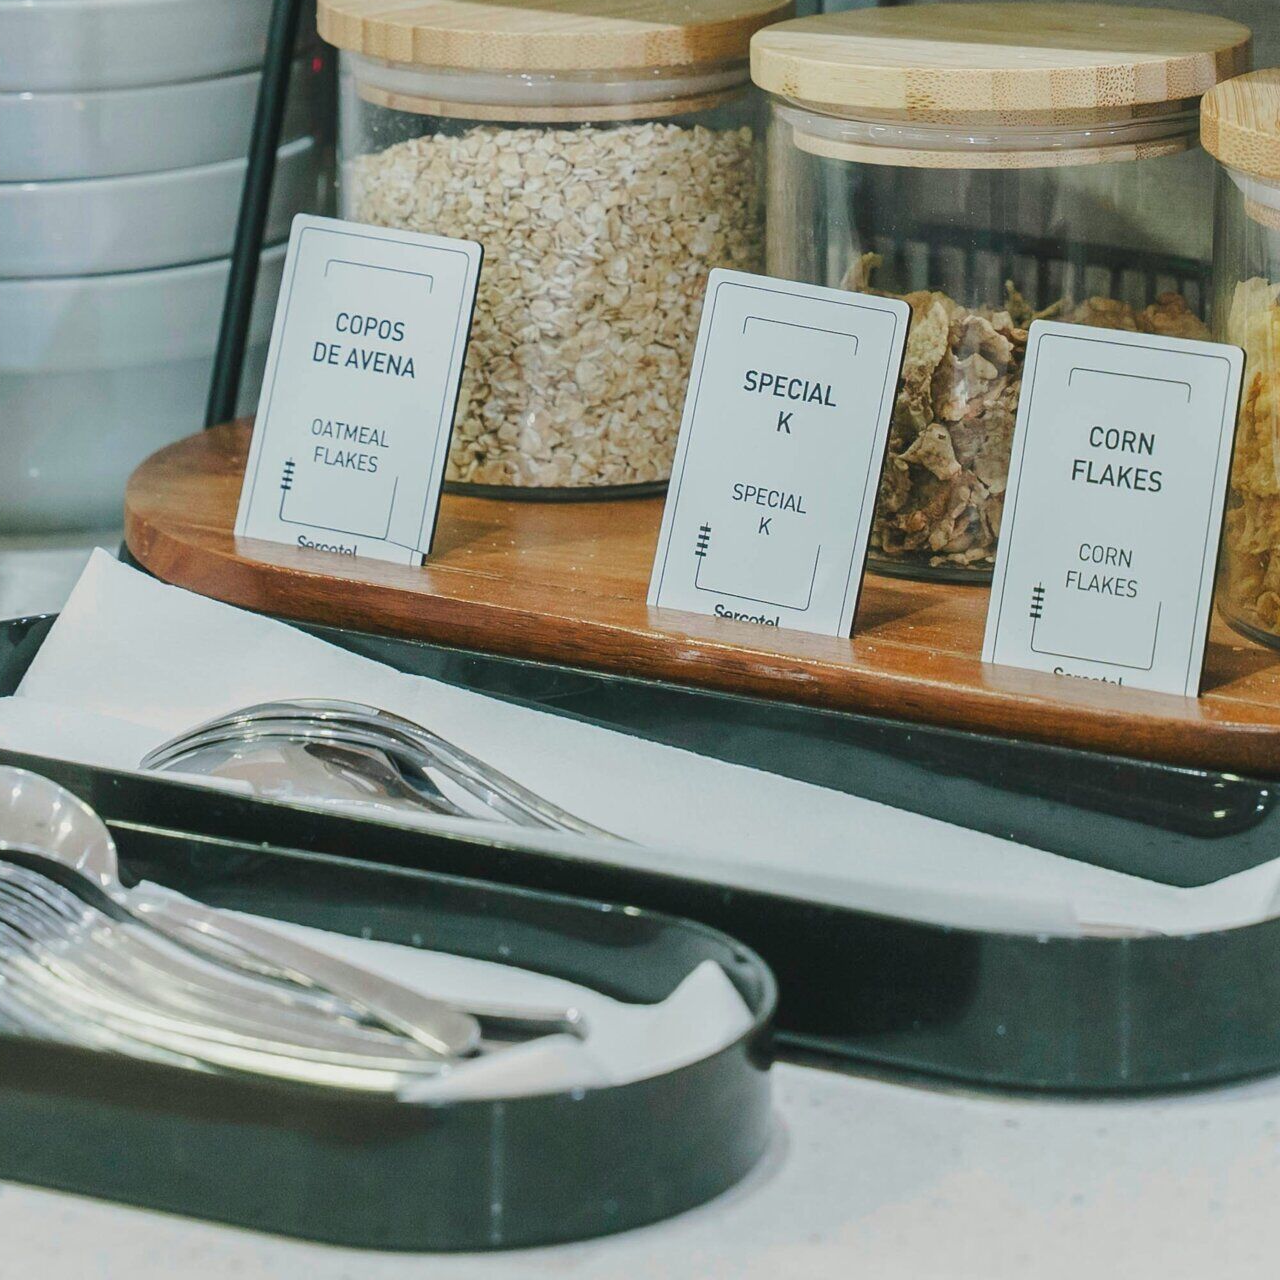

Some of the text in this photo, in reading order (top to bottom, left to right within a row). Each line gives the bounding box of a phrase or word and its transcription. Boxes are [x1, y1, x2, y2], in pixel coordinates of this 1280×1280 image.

[335, 312, 405, 342] COPOS
[312, 341, 415, 379] DE AVENA
[743, 370, 837, 408] SPECIAL
[311, 418, 390, 449] OATMEAL
[776, 410, 794, 435] K
[1089, 426, 1156, 456] CORN
[313, 445, 379, 474] FLAKES
[1071, 459, 1163, 493] FLAKES
[731, 483, 807, 515] SPECIAL
[758, 516, 773, 536] K
[1078, 543, 1133, 569] CORN
[1065, 569, 1138, 599] FLAKES
